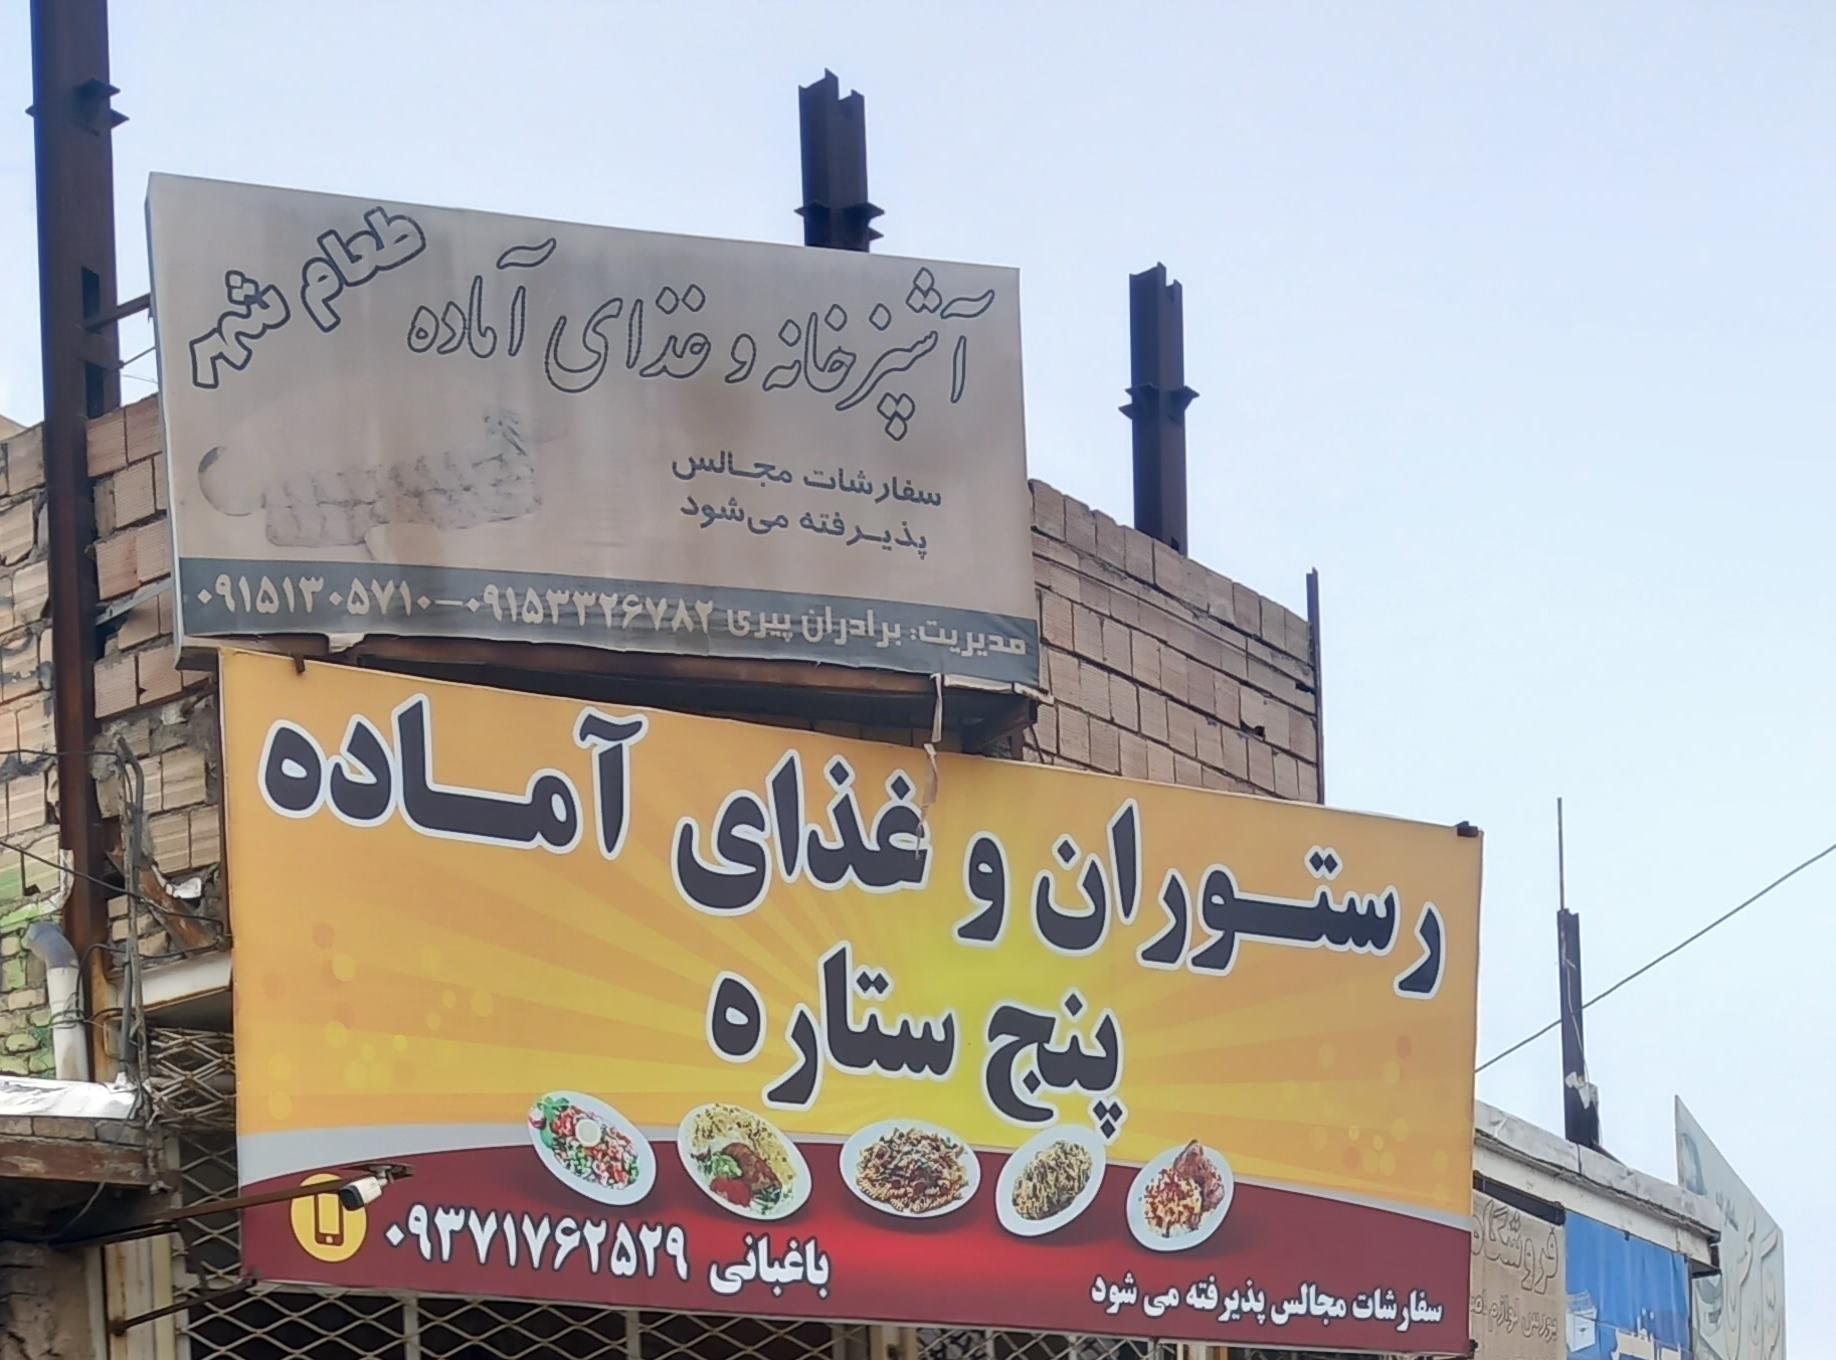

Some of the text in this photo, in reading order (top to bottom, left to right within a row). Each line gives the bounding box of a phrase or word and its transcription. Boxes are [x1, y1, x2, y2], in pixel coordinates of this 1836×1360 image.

[301, 206, 427, 332] طعام
[408, 238, 996, 442] آشپزخانه و غذای آماده
[671, 450, 943, 508] سفارشات مجالس
[799, 510, 928, 560] پذیرفته
[726, 606, 792, 645] پیری
[801, 605, 902, 649] برادران
[259, 693, 1444, 997] رستوران و غذای آماده
[706, 942, 1125, 1140] پنج ستاره
[385, 1203, 830, 1299] باغبانی ۰۹۳۷۱۷۶۲۵۲۹
[1186, 1274, 1266, 1325] پذیرفته
[1270, 1283, 1347, 1325] مجالس
[1352, 1288, 1443, 1332] سفارشات
